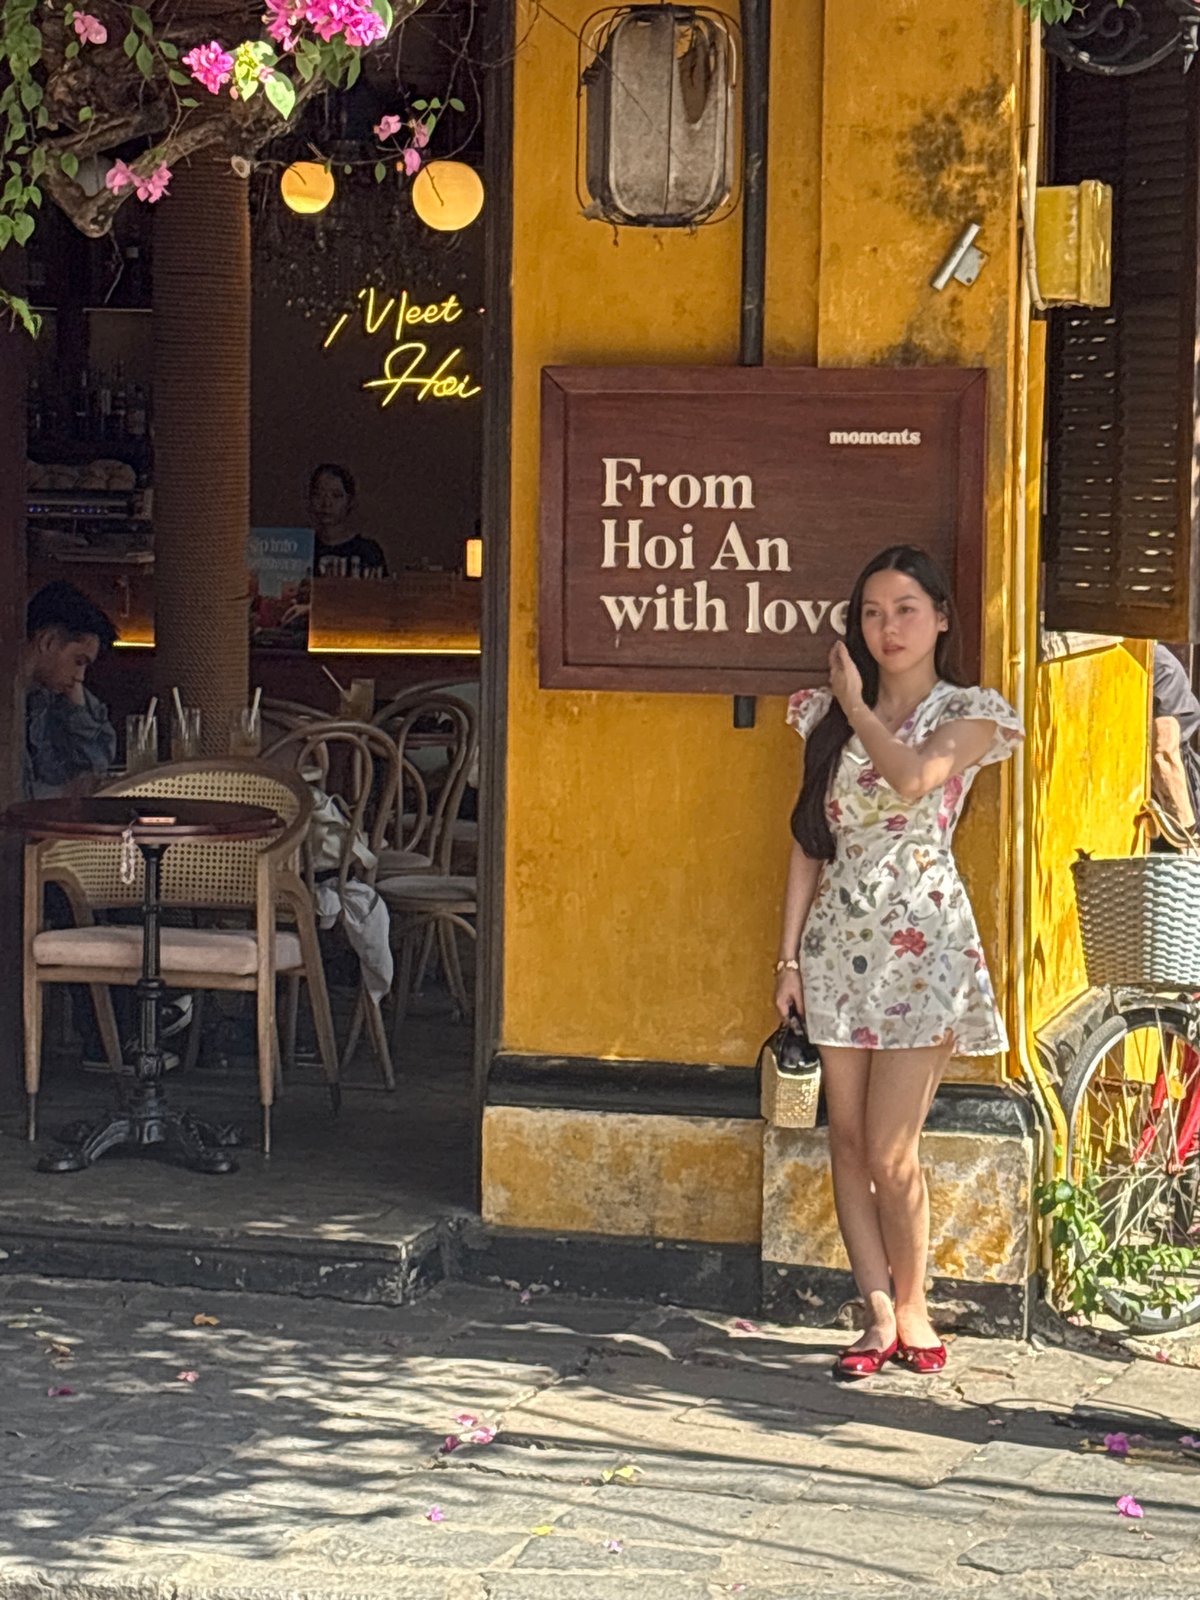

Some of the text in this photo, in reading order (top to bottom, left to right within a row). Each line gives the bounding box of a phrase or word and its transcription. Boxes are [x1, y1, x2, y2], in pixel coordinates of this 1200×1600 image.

[324, 287, 463, 347] Meet
[362, 341, 482, 407] Hoi
[829, 428, 921, 446] moments
[601, 458, 755, 509] From
[601, 519, 791, 573] Hoi An
[600, 580, 850, 635] with love
